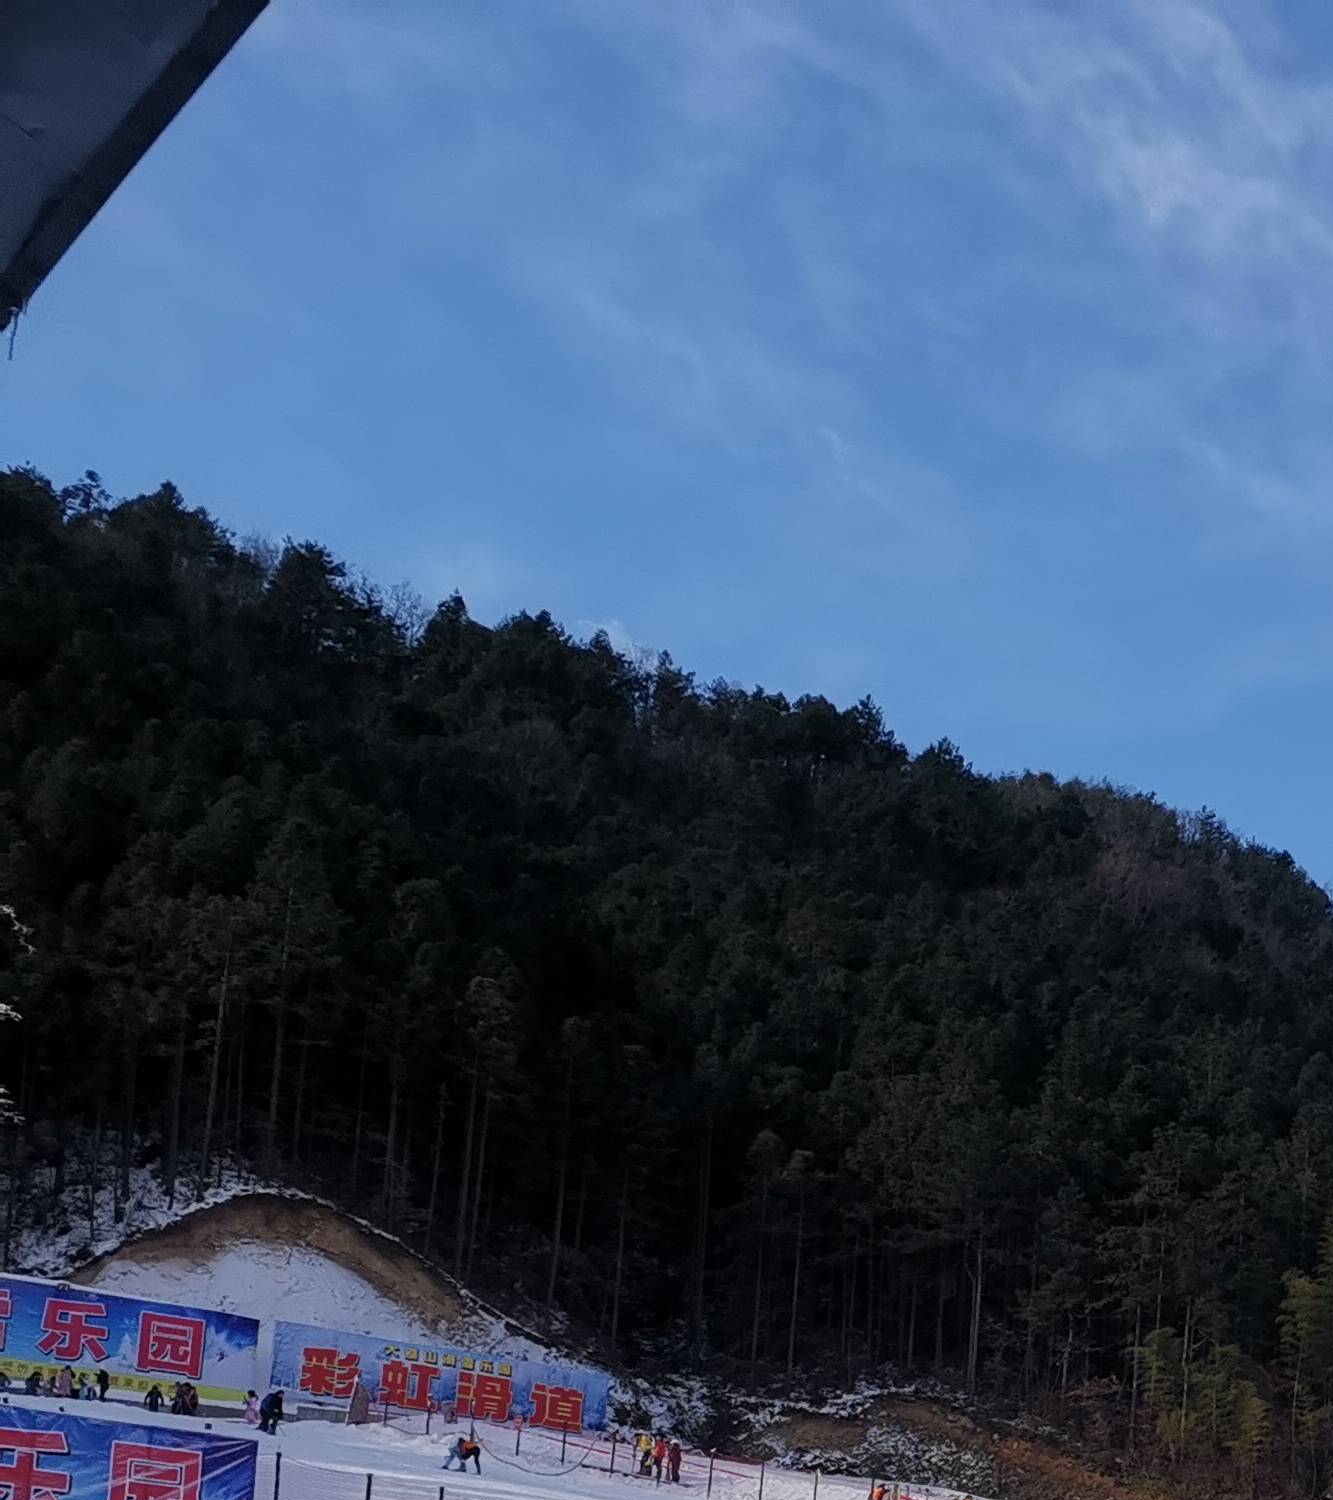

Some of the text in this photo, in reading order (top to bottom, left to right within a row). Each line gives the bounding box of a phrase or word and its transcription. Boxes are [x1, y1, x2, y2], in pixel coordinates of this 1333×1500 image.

[0, 1288, 206, 1379] 乐园
[299, 1346, 584, 1434] 彩虹滑道
